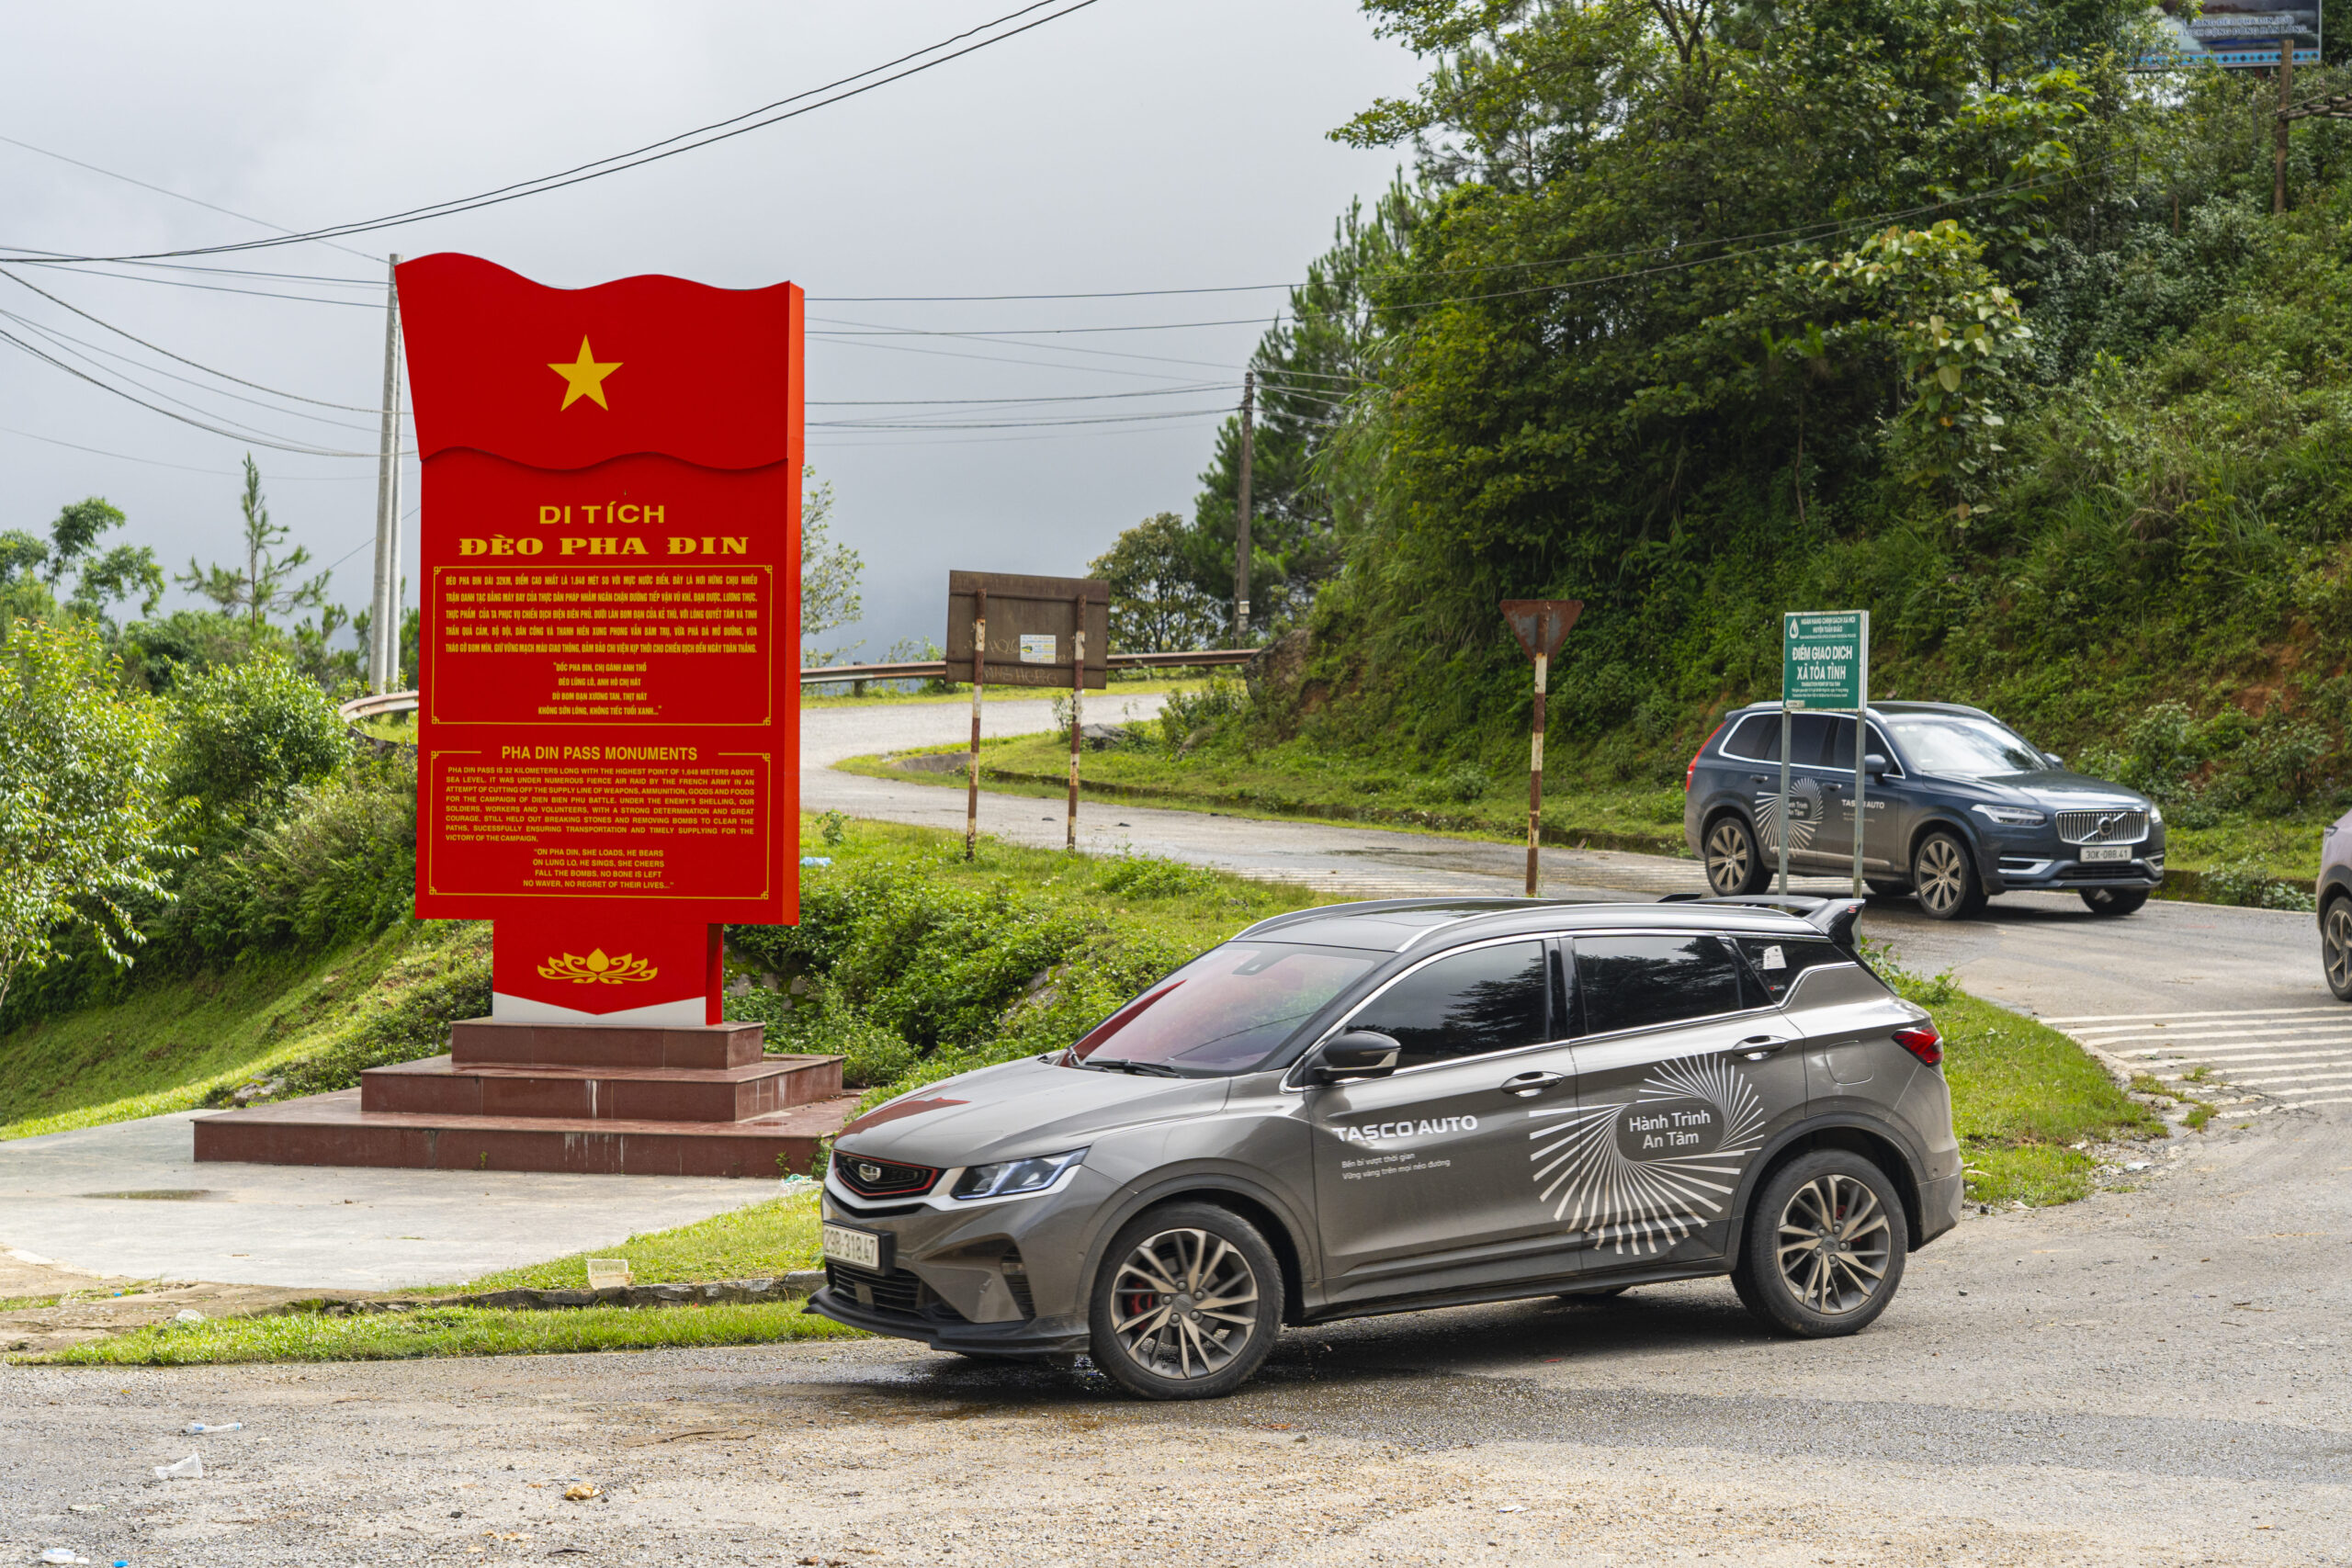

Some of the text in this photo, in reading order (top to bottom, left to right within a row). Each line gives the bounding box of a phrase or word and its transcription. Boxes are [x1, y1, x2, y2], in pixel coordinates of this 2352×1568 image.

[540, 501, 664, 525] DI TÍCH
[458, 535, 749, 555] ĐÈO PHA ĐIN
[1792, 643, 1852, 661] ĐIỂM GIAO DỊCH
[1797, 661, 1846, 680] XÃ TỎA TÌNH
[502, 747, 697, 760] PHA DIN PASS MONUMENTS
[1866, 801, 1884, 809] AUTO
[1332, 1115, 1478, 1142] TASCO AUTO
[1629, 1110, 1711, 1132] Hành Trình
[1643, 1131, 1699, 1149] An Tâm
[1399, 1153, 1415, 1162] gian
